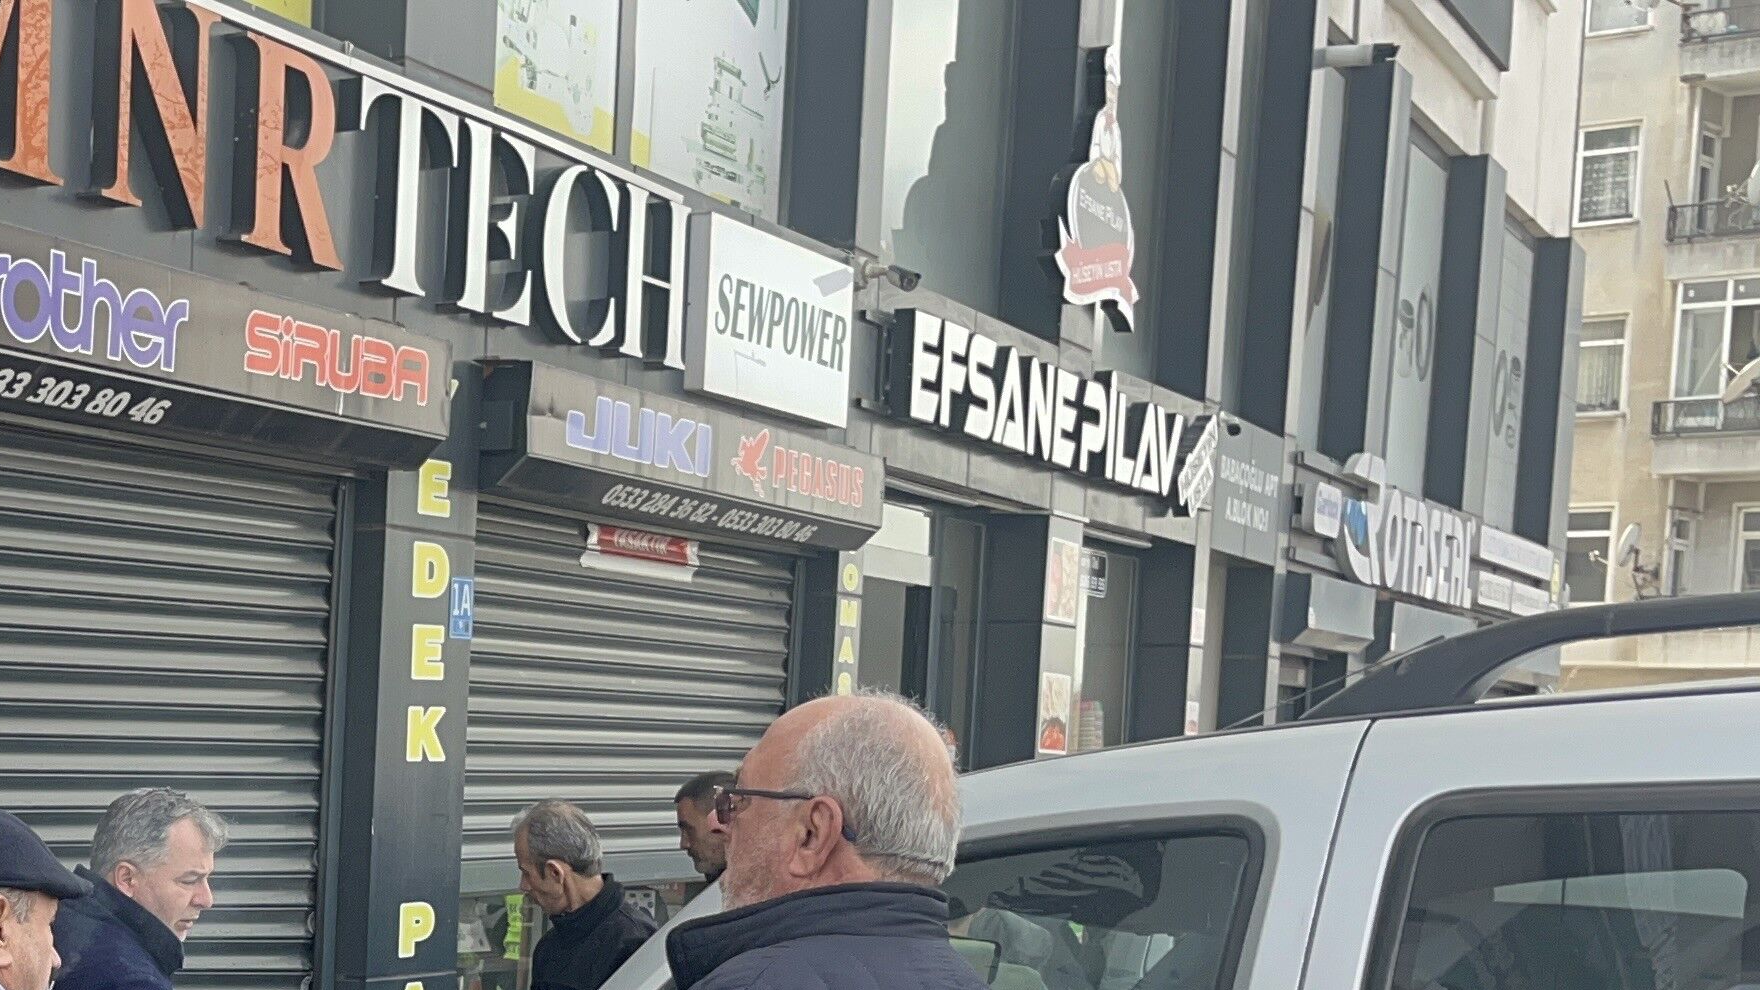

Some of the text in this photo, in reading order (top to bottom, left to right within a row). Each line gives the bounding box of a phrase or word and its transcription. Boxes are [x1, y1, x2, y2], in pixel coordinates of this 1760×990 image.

[714, 273, 847, 373] SEWPOWER
[25, 376, 90, 411] 303
[84, 388, 131, 418] 80
[128, 397, 172, 425] 46
[565, 395, 713, 478] JUKI
[771, 445, 865, 508] PEGASUS
[601, 484, 648, 509] 0533
[640, 491, 678, 515] 284
[670, 497, 698, 519] 36
[690, 501, 718, 523] 82
[717, 508, 759, 532] 0533
[750, 515, 784, 535] 303
[405, 458, 453, 763] EDEK
[451, 583, 471, 616] 1A
